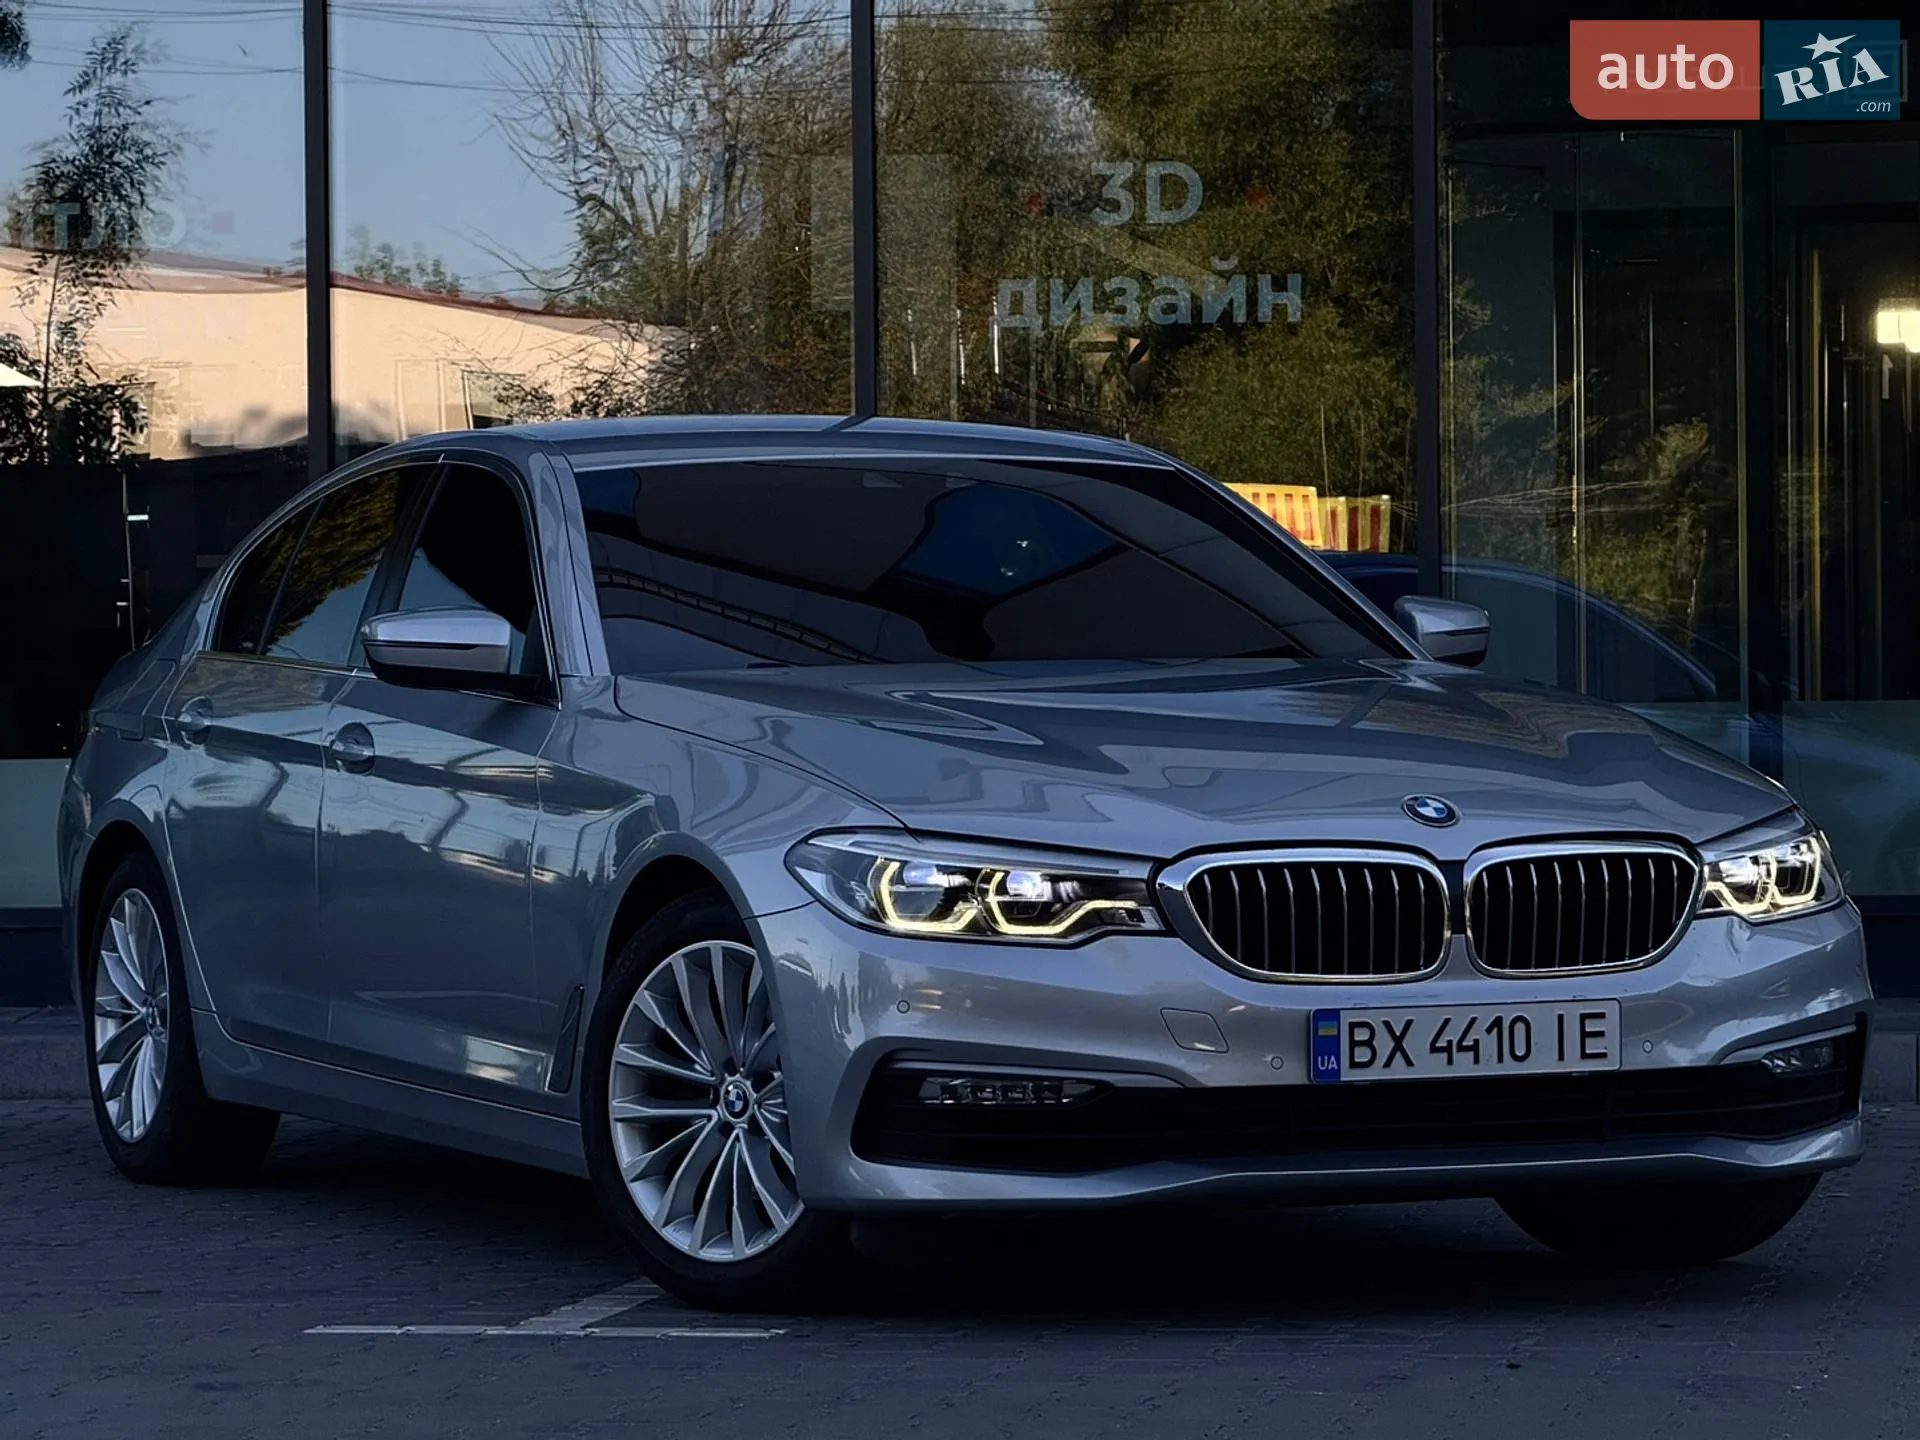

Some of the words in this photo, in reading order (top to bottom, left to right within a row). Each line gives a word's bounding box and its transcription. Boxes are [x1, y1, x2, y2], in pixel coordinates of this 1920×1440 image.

[1091, 160, 1205, 228] 3D
[995, 254, 1304, 337] дизайн
[1317, 1054, 1339, 1071] UA
[1348, 1018, 1414, 1068] BX
[1429, 1014, 1532, 1065] 4410
[1557, 1012, 1608, 1060] IE
